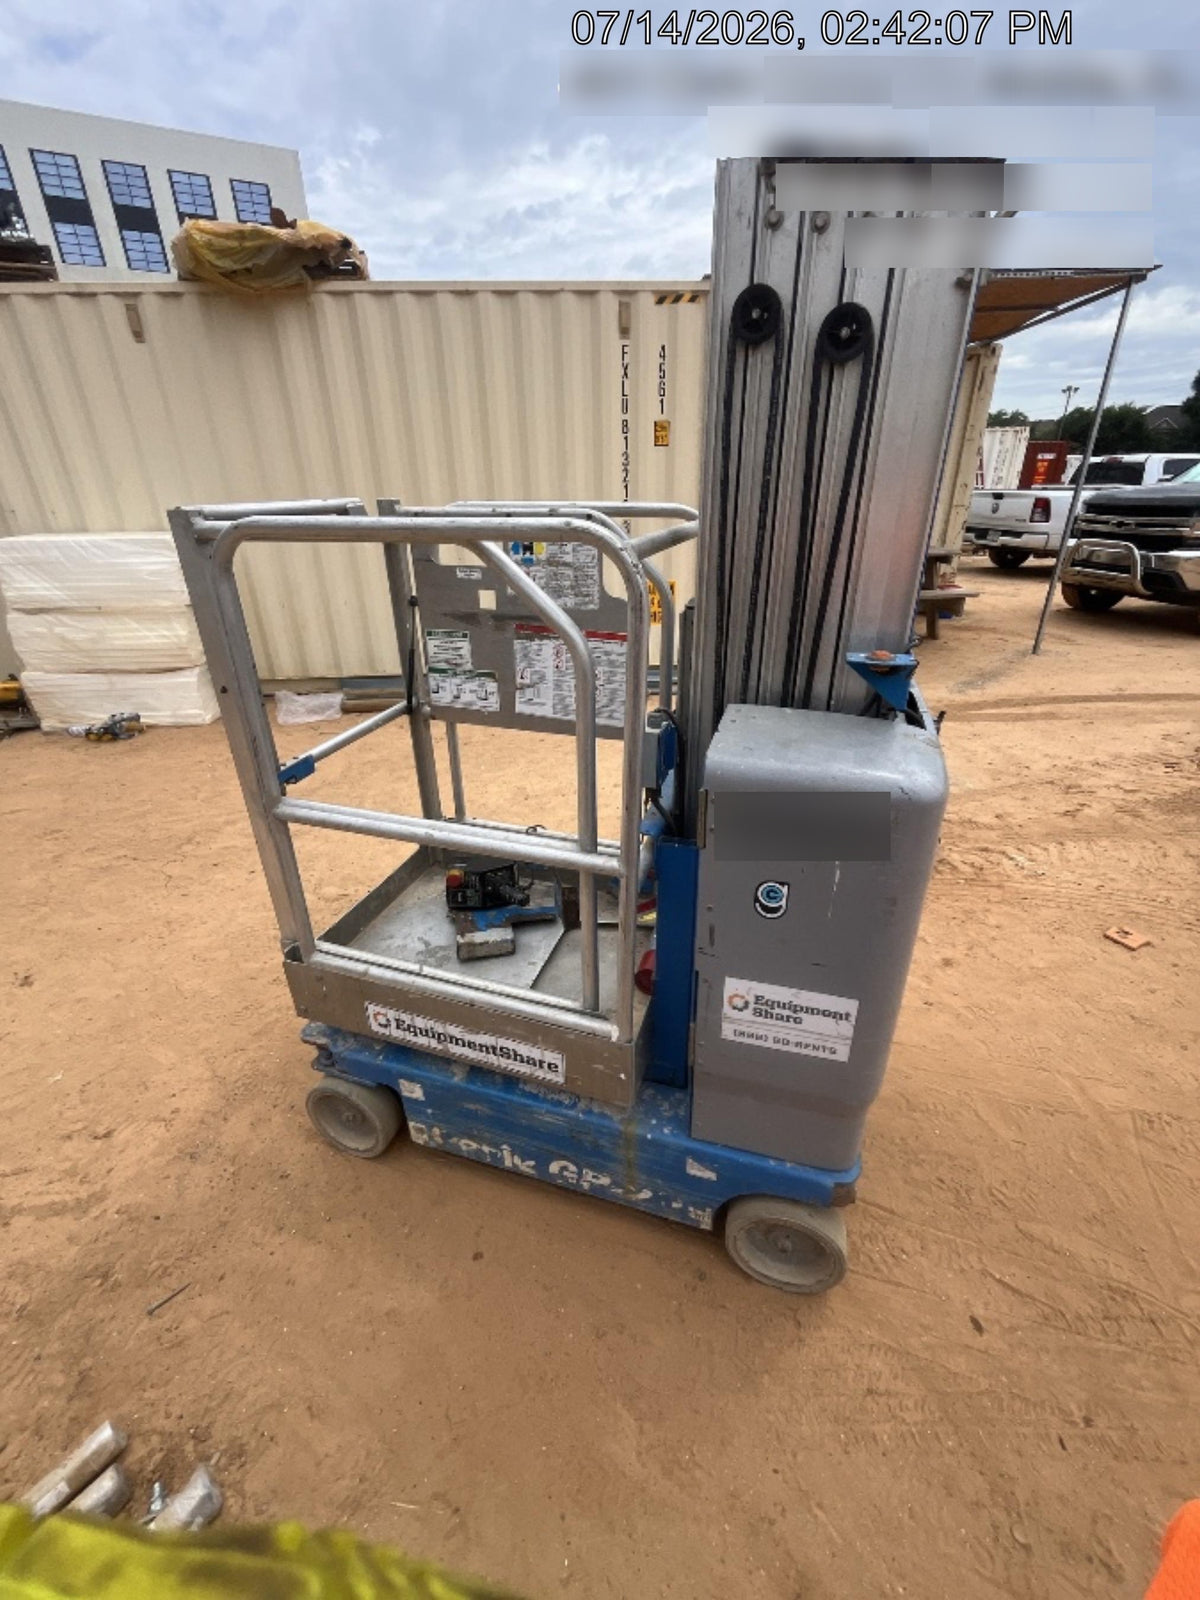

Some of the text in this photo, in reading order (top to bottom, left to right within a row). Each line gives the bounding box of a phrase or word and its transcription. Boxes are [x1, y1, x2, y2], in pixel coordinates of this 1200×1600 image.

[621, 344, 630, 415] FXLU
[751, 1007, 803, 1025] Share
[753, 994, 852, 1022] Equipment
[394, 1017, 560, 1074] EquipmentShare
